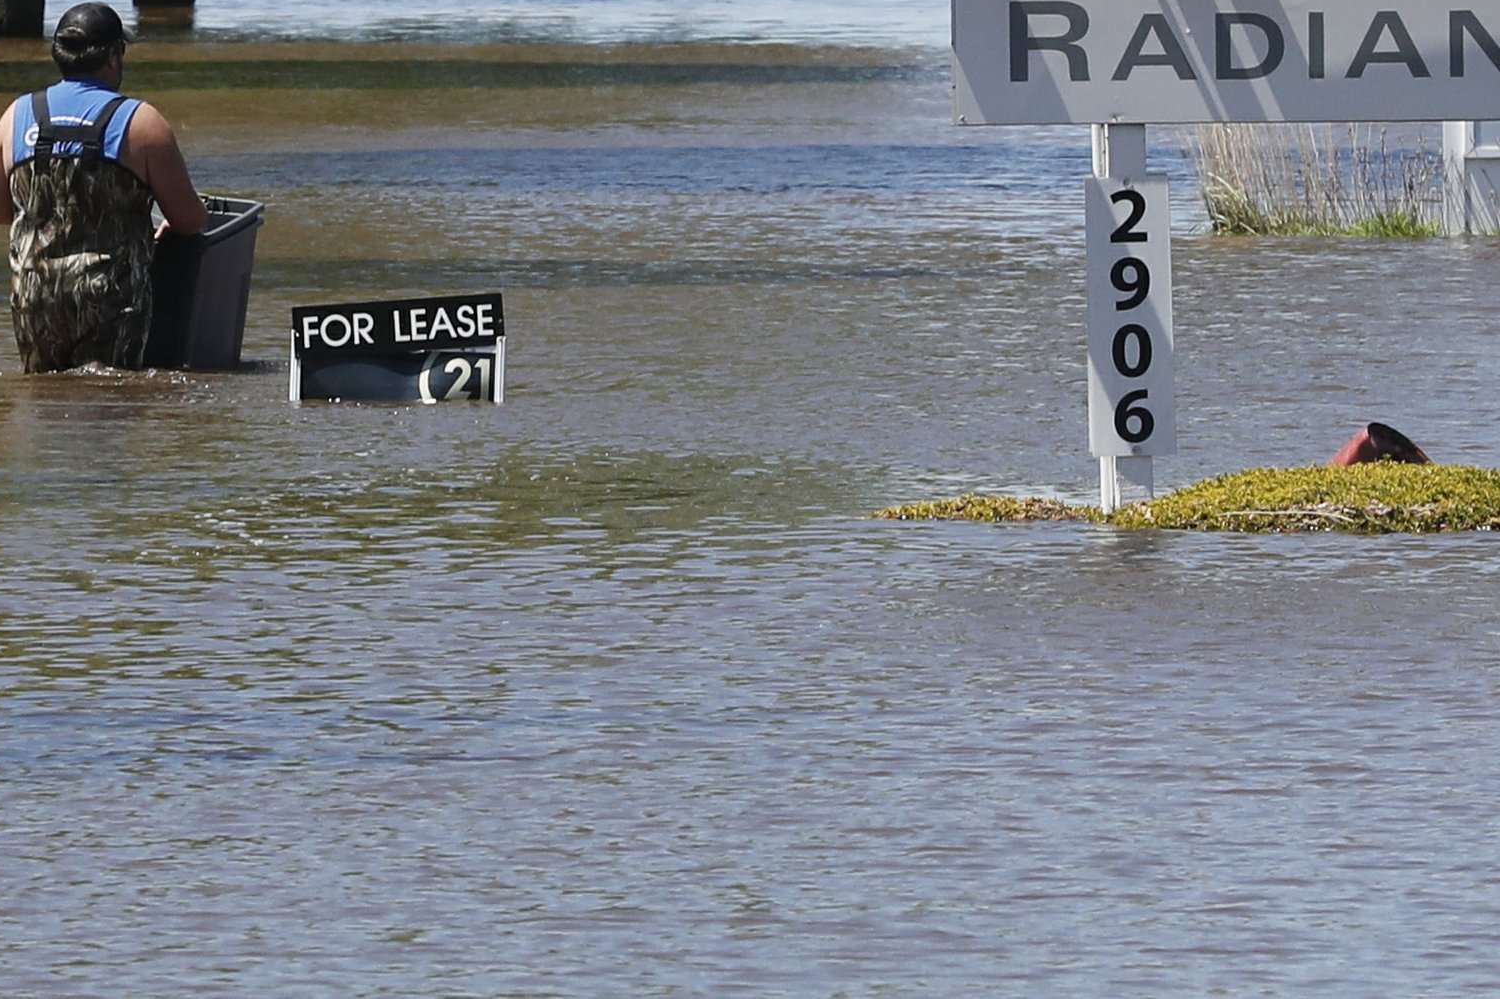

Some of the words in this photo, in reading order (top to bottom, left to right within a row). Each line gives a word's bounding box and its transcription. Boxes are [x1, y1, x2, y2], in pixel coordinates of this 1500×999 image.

[1008, 0, 1500, 82] RADIAN
[302, 312, 375, 349] FOR
[392, 303, 495, 343] LEASE
[1108, 188, 1155, 444] 2906
